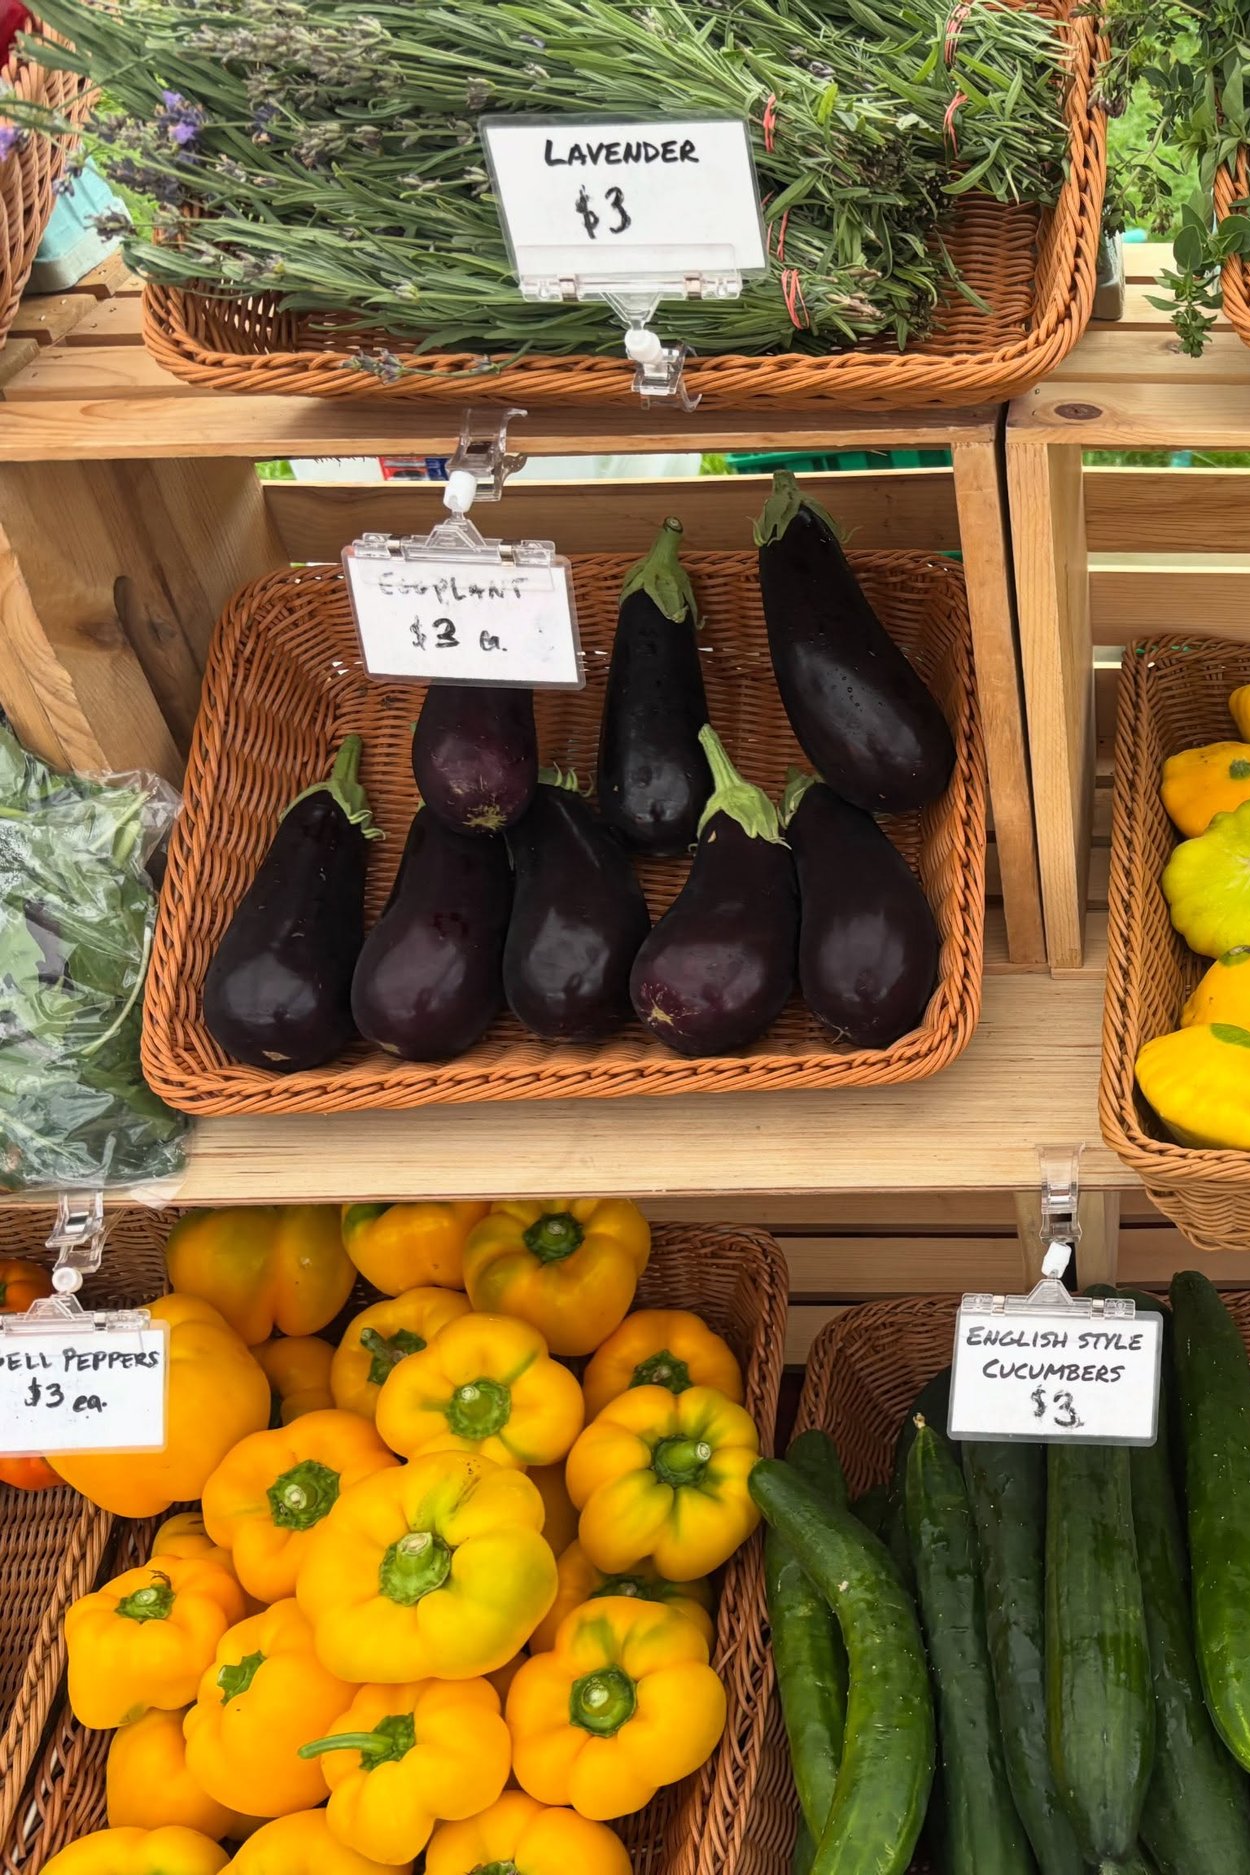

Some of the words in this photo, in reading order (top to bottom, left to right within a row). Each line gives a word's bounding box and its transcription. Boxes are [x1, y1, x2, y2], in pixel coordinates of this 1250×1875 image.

[545, 139, 699, 167] LAVENDER
[575, 184, 631, 239] $3
[966, 1326, 1068, 1349] ENGLISH
[1078, 1332, 1143, 1351] STYLE
[62, 1347, 160, 1372] PEPPERS
[982, 1358, 1125, 1383] CUCUMBERS
[24, 1377, 65, 1408] $3
[72, 1394, 107, 1413] ea.
[1031, 1384, 1085, 1428] $3
